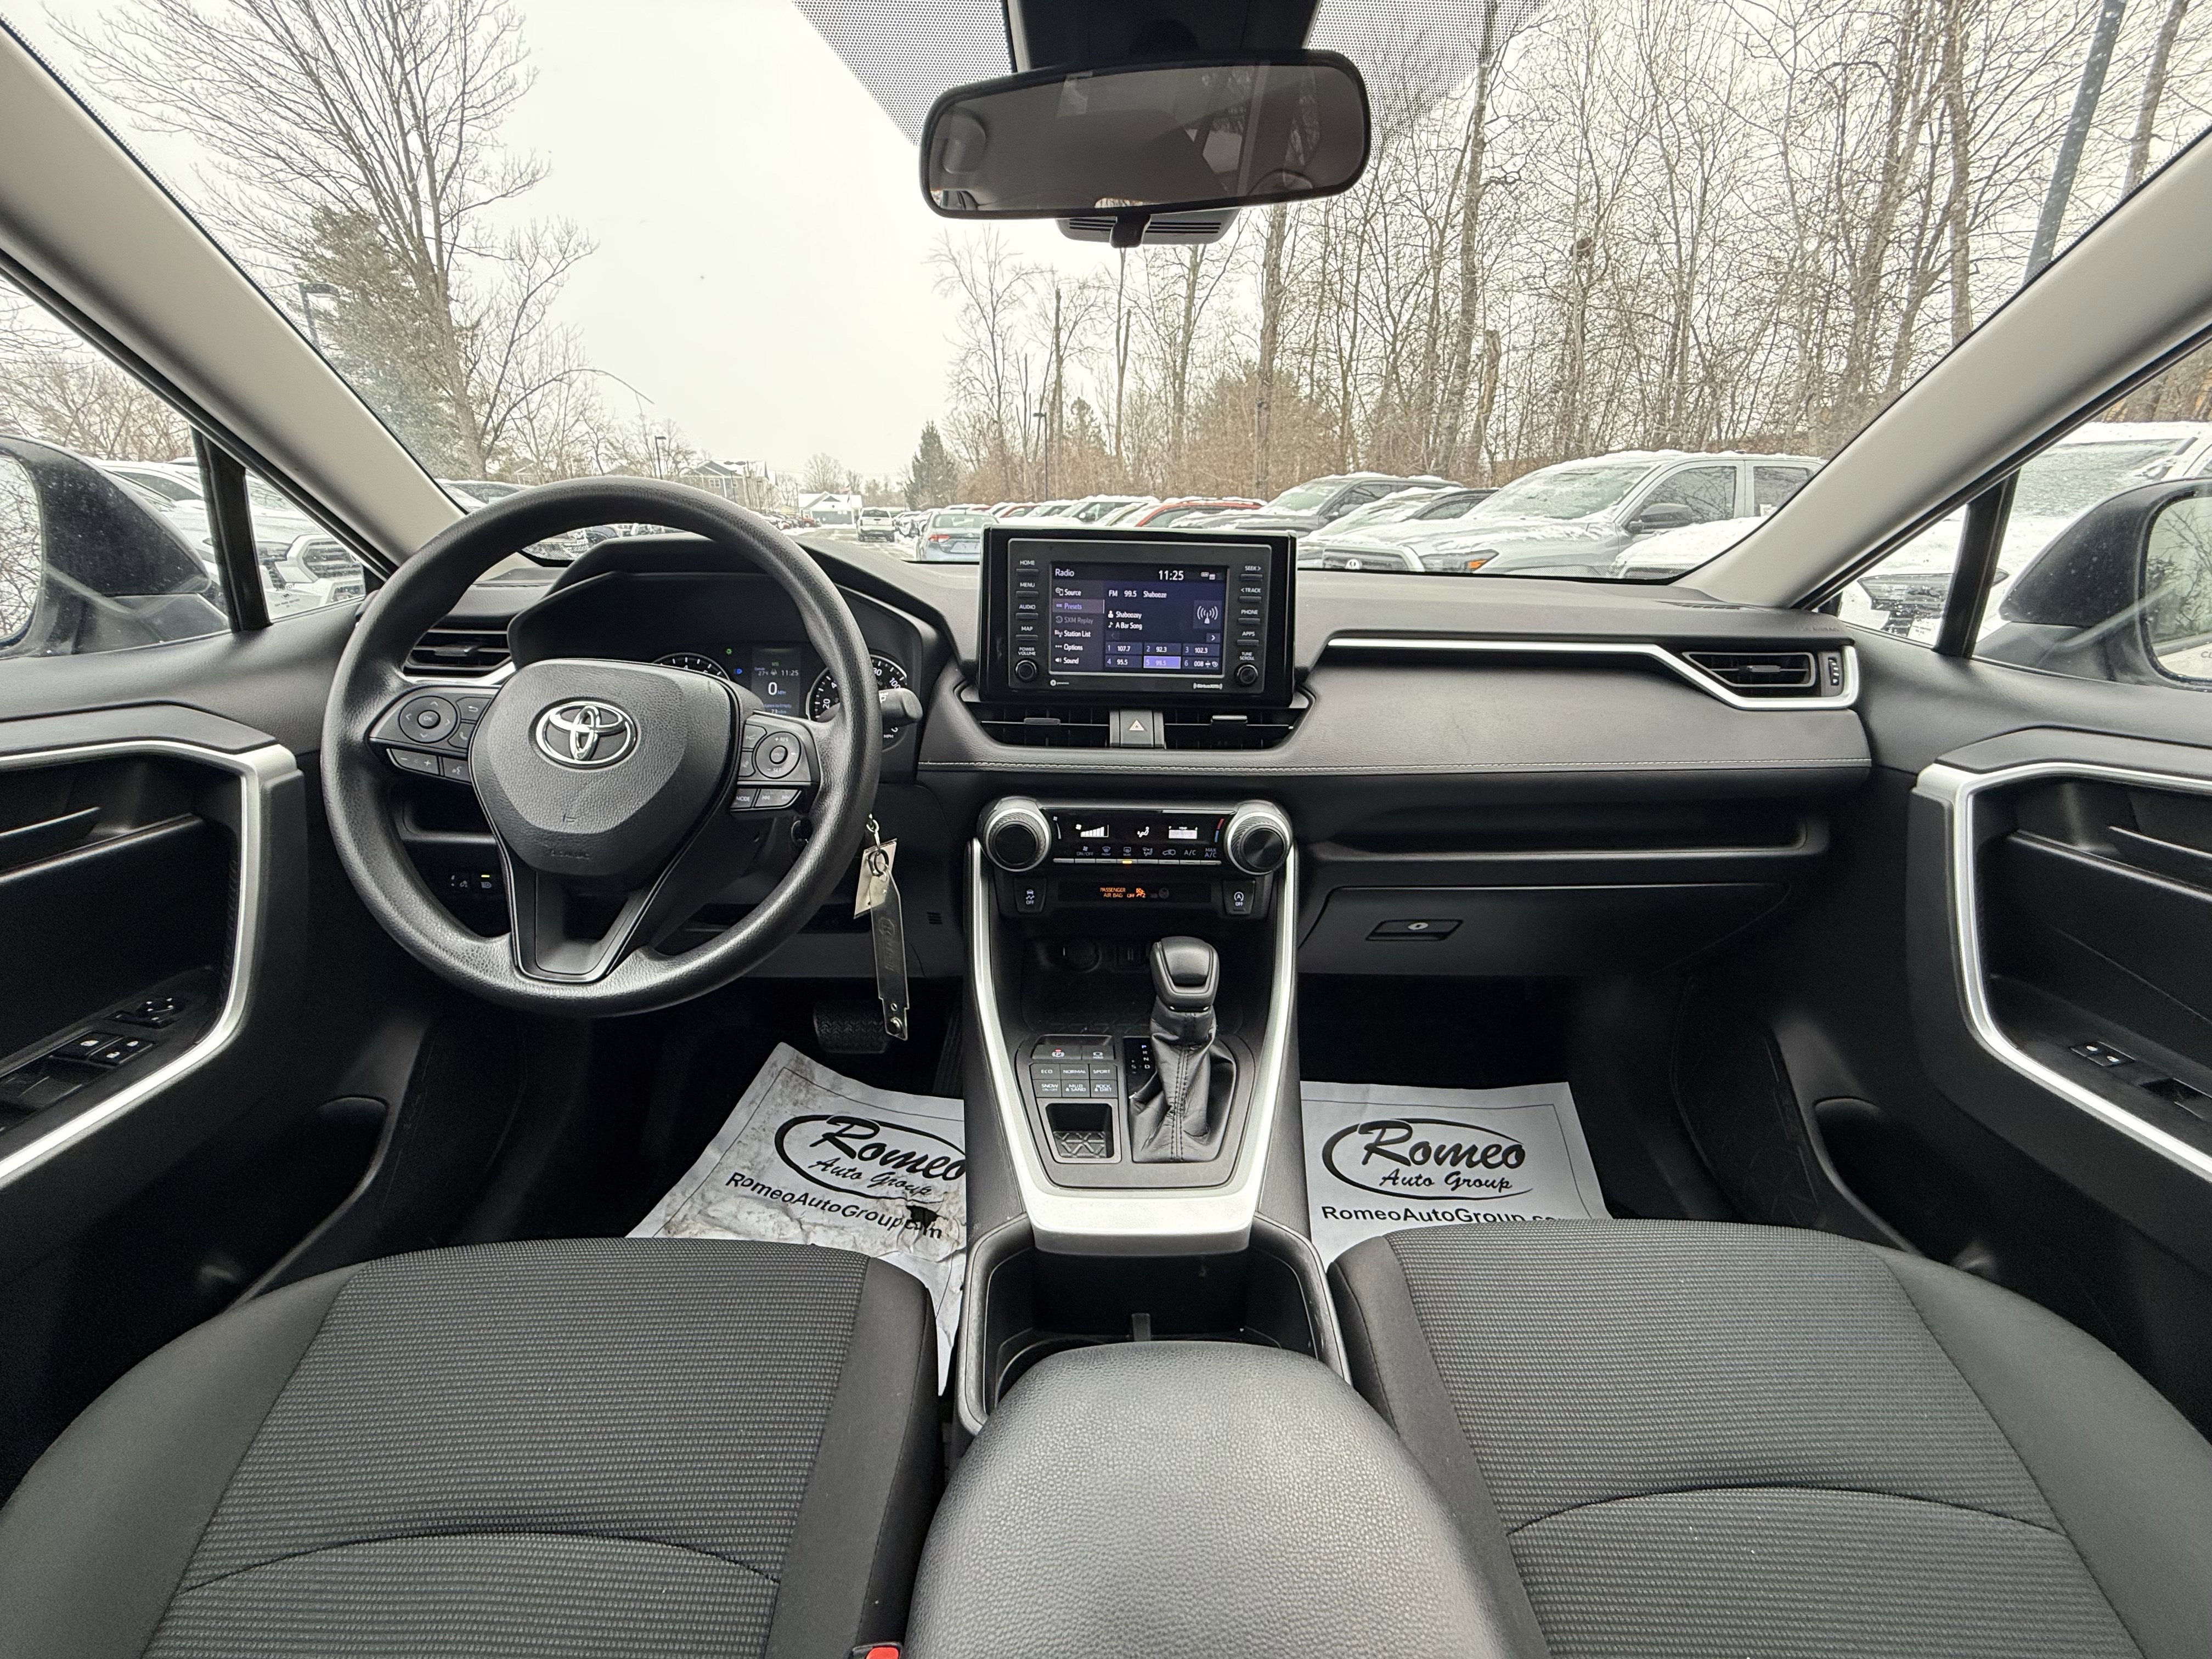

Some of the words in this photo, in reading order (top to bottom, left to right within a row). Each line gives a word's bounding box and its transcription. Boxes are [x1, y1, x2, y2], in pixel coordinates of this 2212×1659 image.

[1055, 568, 1075, 577] Radio
[1159, 570, 1184, 580] 11:25
[1077, 617, 1094, 625] Replay
[1130, 622, 1143, 630] Song
[1063, 644, 1084, 652] Options
[768, 681, 777, 696] 0
[889, 677, 901, 689] 100
[822, 698, 831, 709] 20
[809, 1115, 966, 1181] Romeo
[1358, 1119, 1526, 1169] Romeo
[808, 1157, 863, 1180] Auto
[870, 1172, 932, 1196] Group
[1379, 1168, 1435, 1187] Auto
[1444, 1170, 1512, 1193] Group
